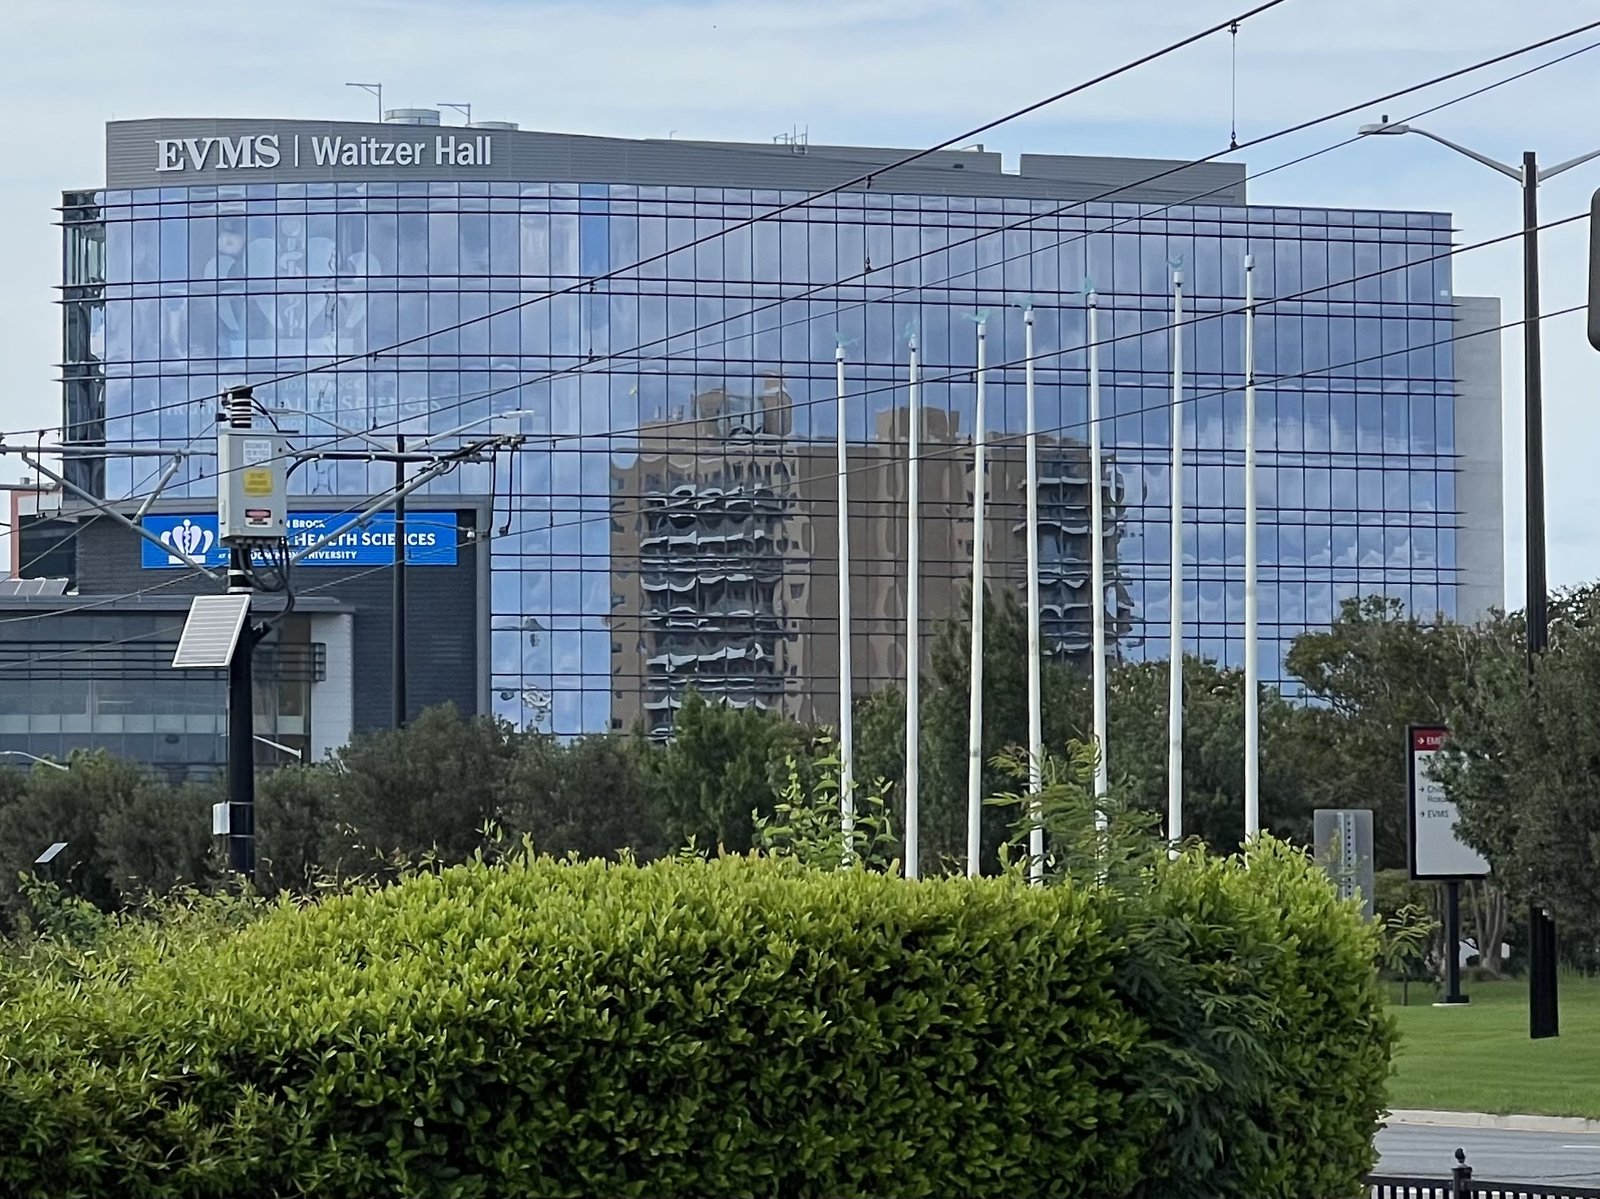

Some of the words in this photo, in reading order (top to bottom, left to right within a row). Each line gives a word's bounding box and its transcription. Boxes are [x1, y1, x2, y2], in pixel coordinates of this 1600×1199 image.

[155, 134, 281, 172] EVMS
[311, 136, 426, 166] Waitzer
[435, 136, 492, 165] Hall
[304, 551, 357, 560] NIVERSITY
